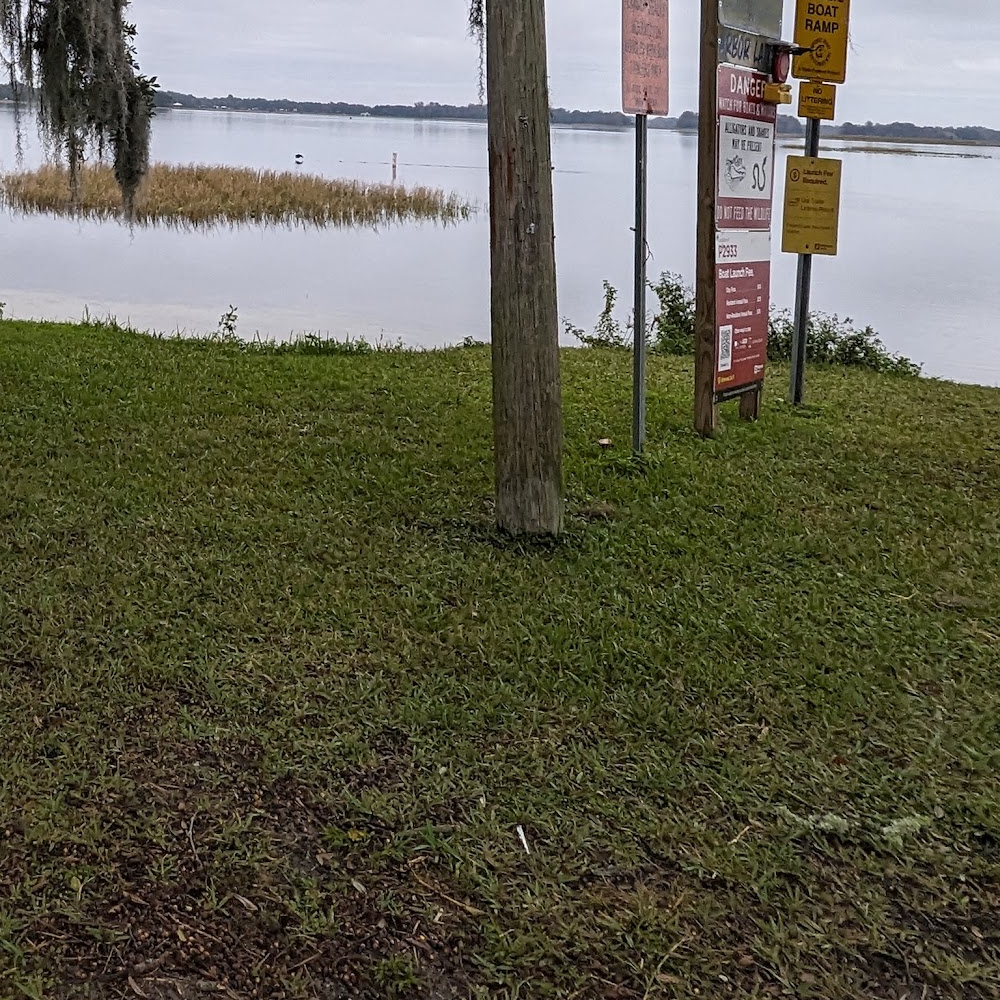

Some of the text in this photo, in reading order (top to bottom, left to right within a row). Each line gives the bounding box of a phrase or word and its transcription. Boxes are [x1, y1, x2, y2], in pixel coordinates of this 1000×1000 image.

[807, 2, 839, 18] BOAT
[805, 18, 839, 34] RAMP
[813, 87, 823, 95] NO
[801, 95, 833, 106] LITTERING
[724, 122, 747, 136] ALLIGATORS
[741, 139, 746, 151] BE
[733, 205, 744, 220] FEED
[718, 244, 738, 258] P2933
